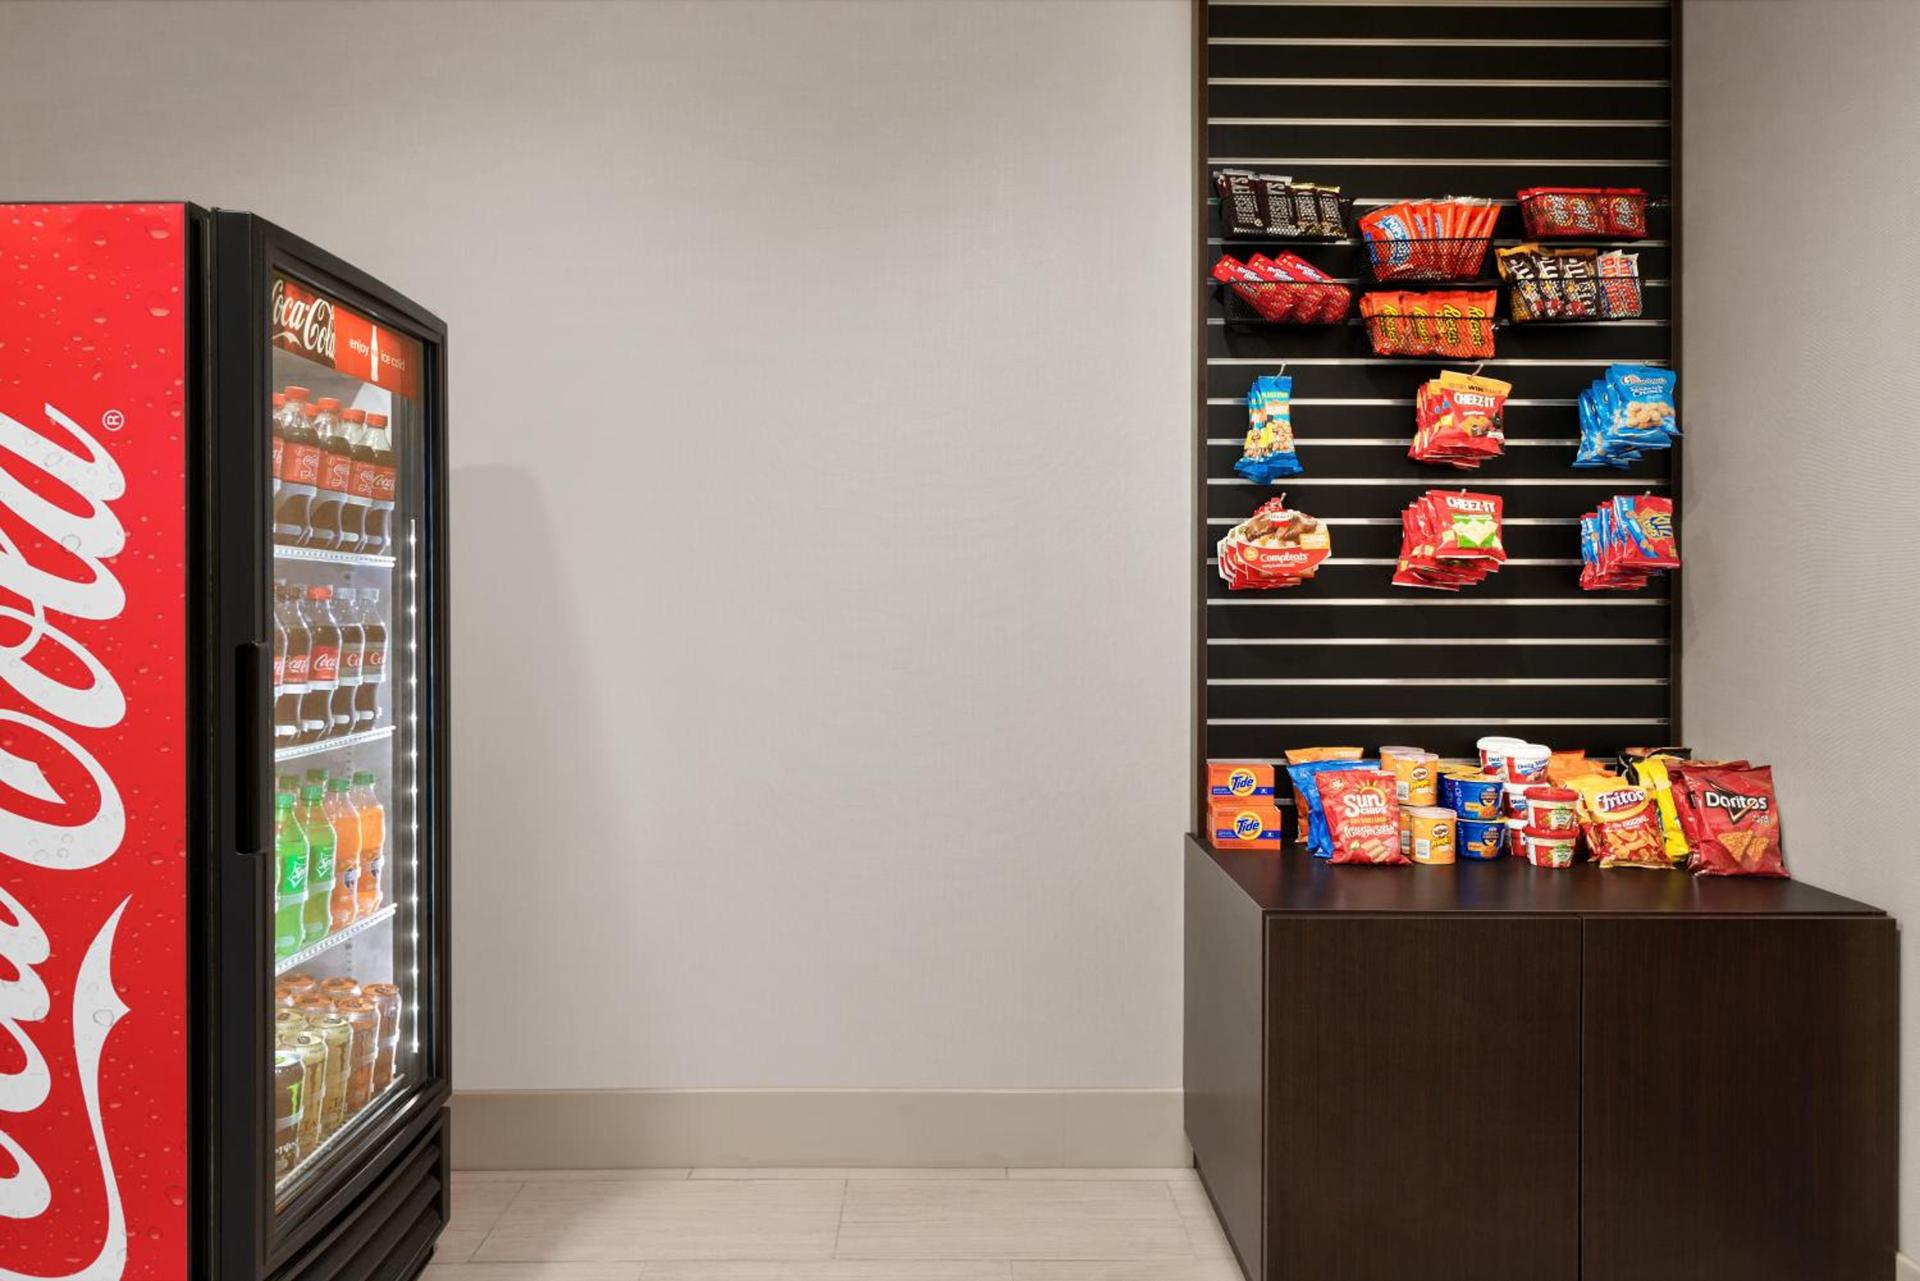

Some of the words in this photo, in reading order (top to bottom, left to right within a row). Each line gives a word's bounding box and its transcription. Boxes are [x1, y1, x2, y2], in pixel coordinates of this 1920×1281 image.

[349, 338, 370, 357] enjoy
[1231, 775, 1254, 791] Tide
[1343, 788, 1387, 818] Sun
[1595, 789, 1645, 812] Fritos
[1705, 790, 1768, 811] Doritos
[1237, 818, 1260, 835] Tide
